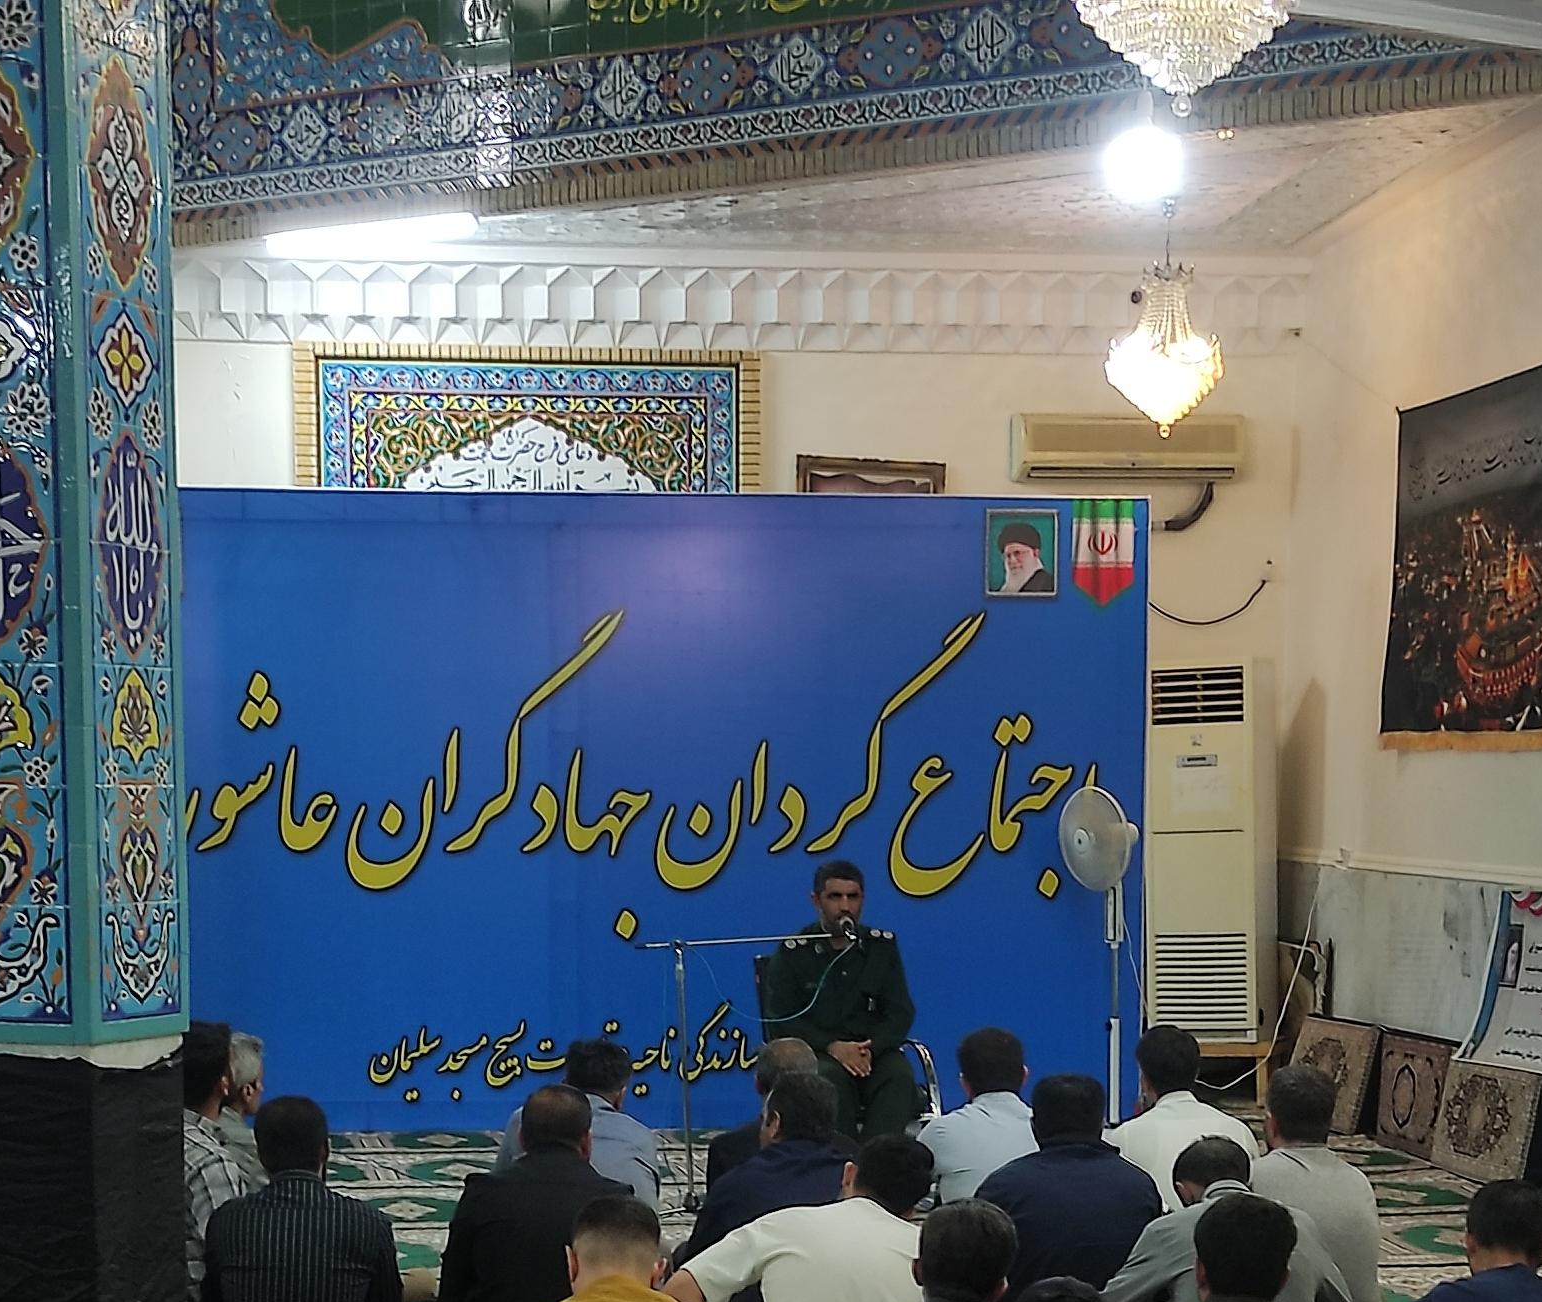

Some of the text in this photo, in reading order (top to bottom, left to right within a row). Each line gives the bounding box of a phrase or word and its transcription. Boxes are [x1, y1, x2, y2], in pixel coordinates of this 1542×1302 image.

[654, 610, 987, 891] گردان
[368, 1026, 442, 1101] سلیمان
[438, 1034, 488, 1100] مسجد
